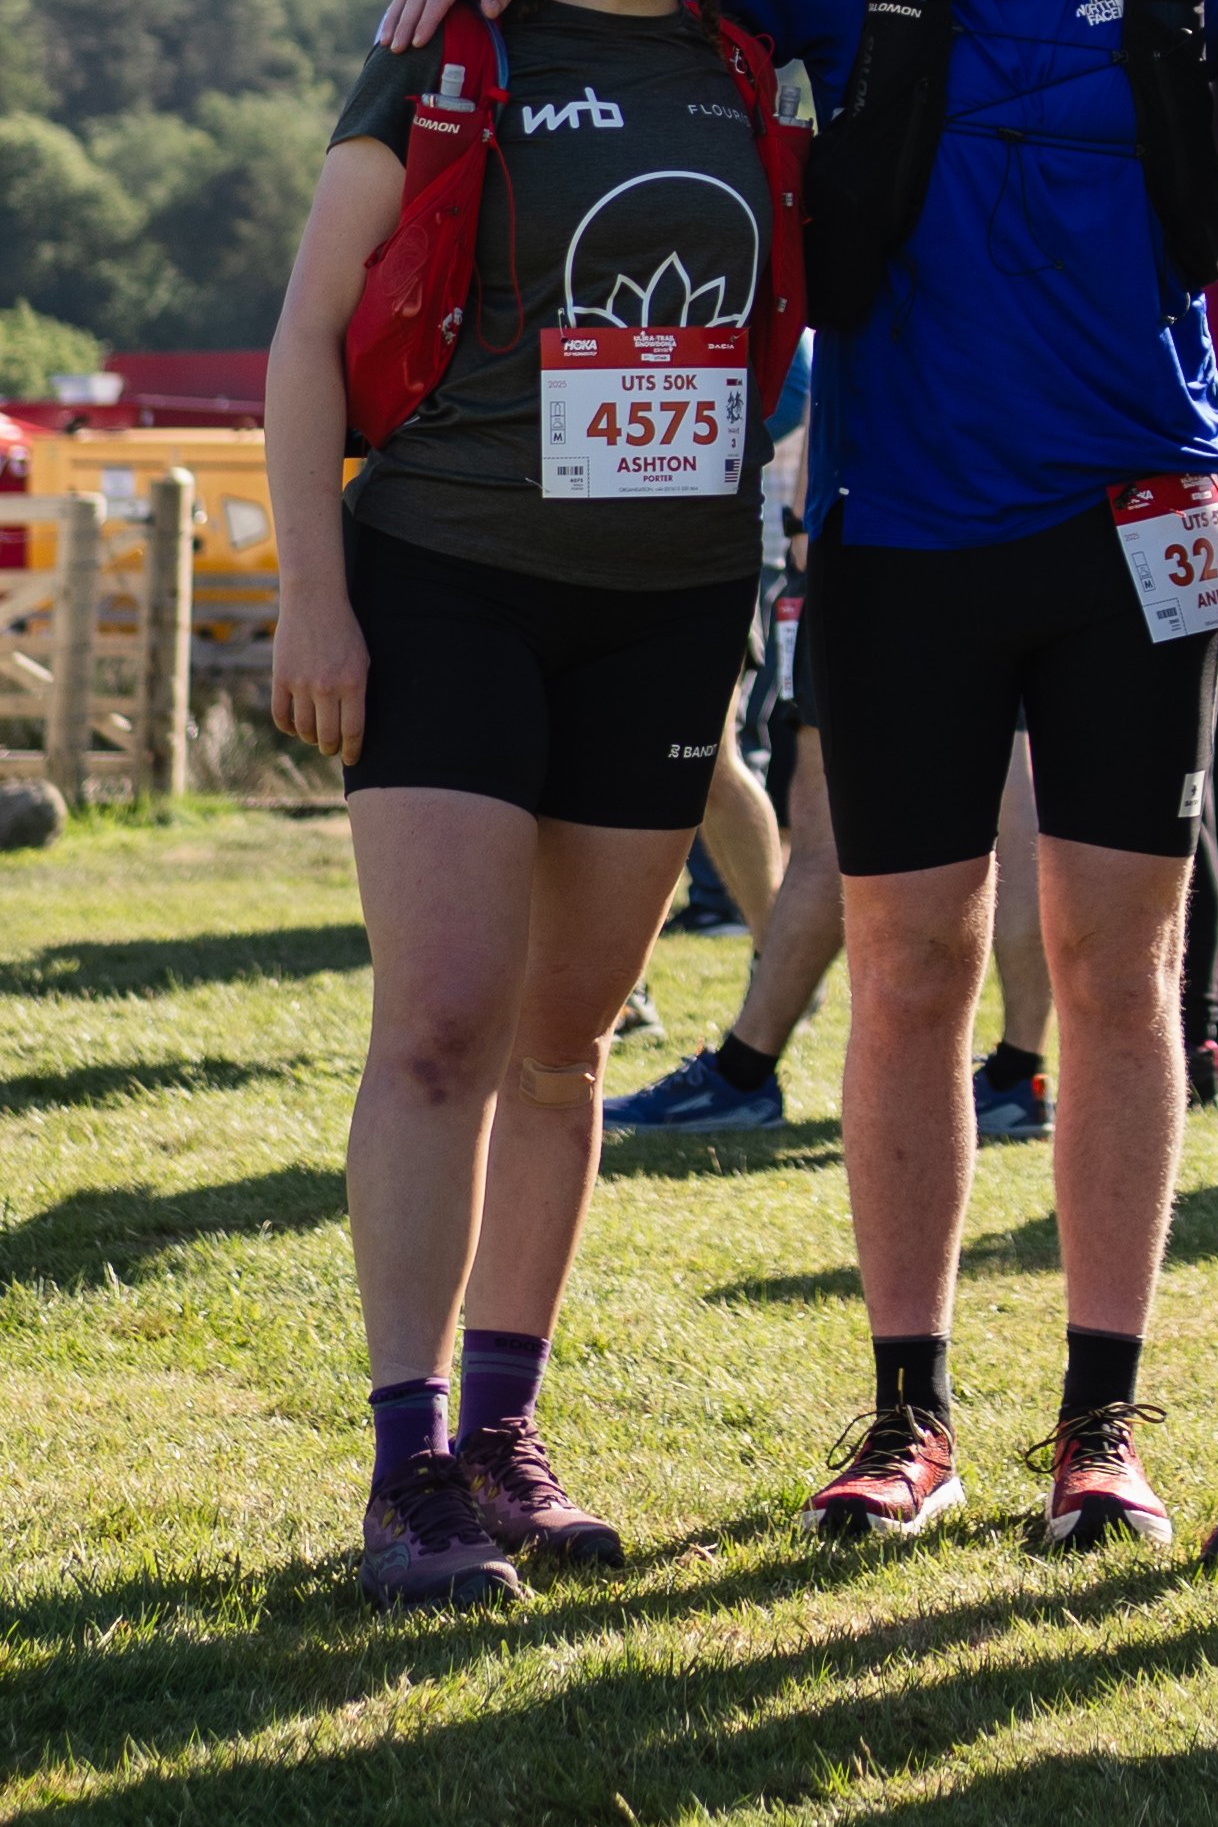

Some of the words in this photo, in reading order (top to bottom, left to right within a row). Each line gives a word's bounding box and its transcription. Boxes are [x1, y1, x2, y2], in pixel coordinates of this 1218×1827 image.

[1087, 7, 1121, 26] FACE
[564, 339, 597, 351] HOKA
[548, 380, 567, 389] 2025
[621, 375, 656, 391] UTS
[663, 374, 698, 390] 50K
[586, 400, 719, 447] 4575
[553, 432, 563, 442] M
[731, 438, 737, 448] 3
[617, 456, 697, 473] ASHTON
[1182, 513, 1209, 531] UTS
[1144, 580, 1153, 589] M
